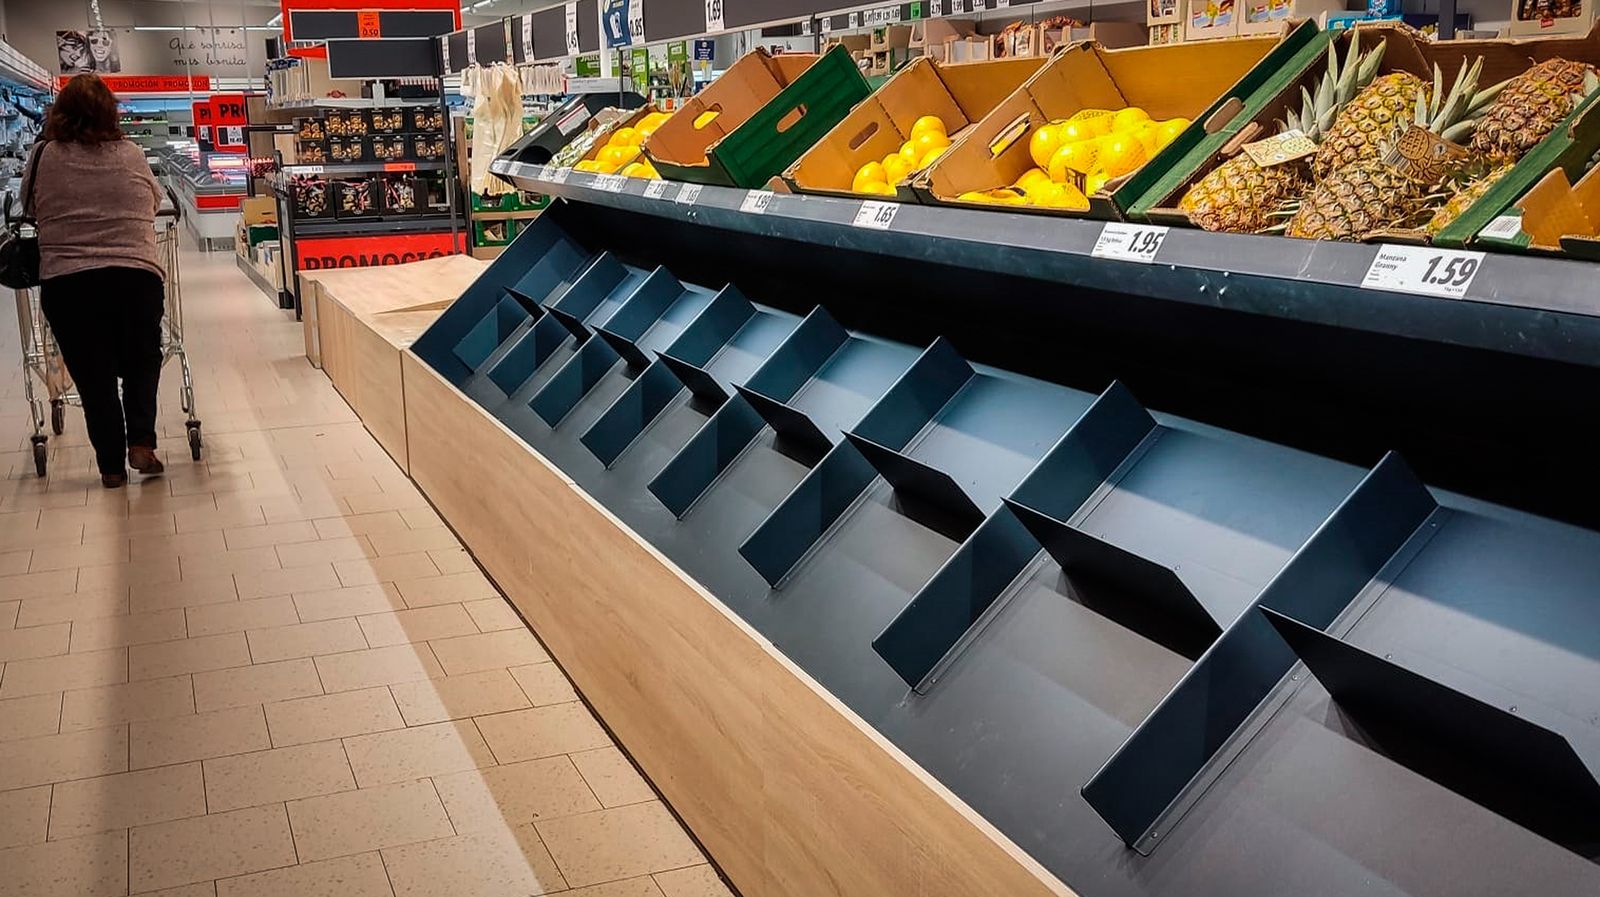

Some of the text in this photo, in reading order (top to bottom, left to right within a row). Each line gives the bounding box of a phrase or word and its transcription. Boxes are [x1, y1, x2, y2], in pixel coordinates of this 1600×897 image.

[874, 205, 896, 223] 1.65
[1128, 230, 1165, 254] 1.95
[1374, 261, 1398, 271] Granny
[1379, 253, 1407, 262] Manzana
[1421, 255, 1478, 287] 1.59
